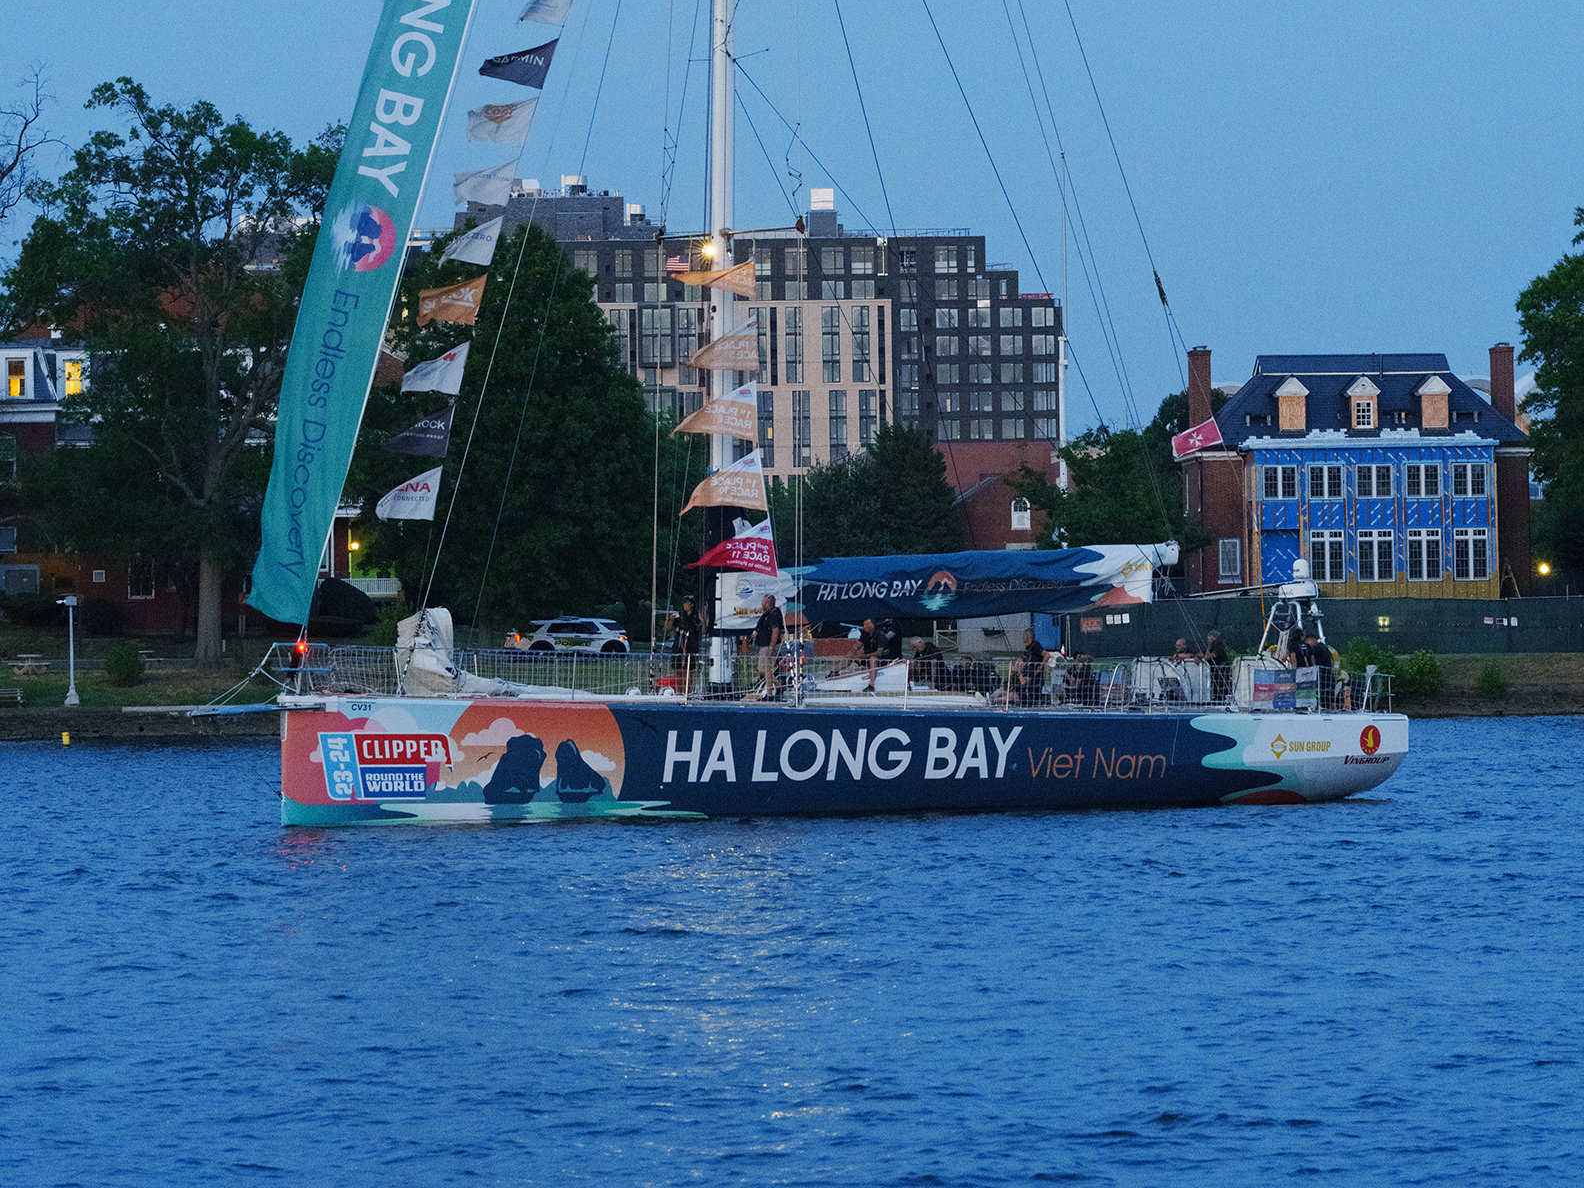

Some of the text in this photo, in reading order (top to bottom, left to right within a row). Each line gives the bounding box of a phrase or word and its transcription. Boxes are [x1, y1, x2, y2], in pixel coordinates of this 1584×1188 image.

[357, 88, 425, 198] BAY
[471, 233, 493, 242] ZERO
[278, 288, 361, 579] Endless Discovery
[816, 579, 923, 601] HA LONG BAY
[964, 581, 1006, 593] Endless
[362, 740, 443, 759] CLIPPER
[662, 726, 1167, 783] HA LONG BAY Viet Nam
[1288, 740, 1332, 752] SUN GROUP
[326, 737, 354, 795] 23-24
[365, 773, 424, 781] ROUND THE
[366, 780, 425, 792] WORLD
